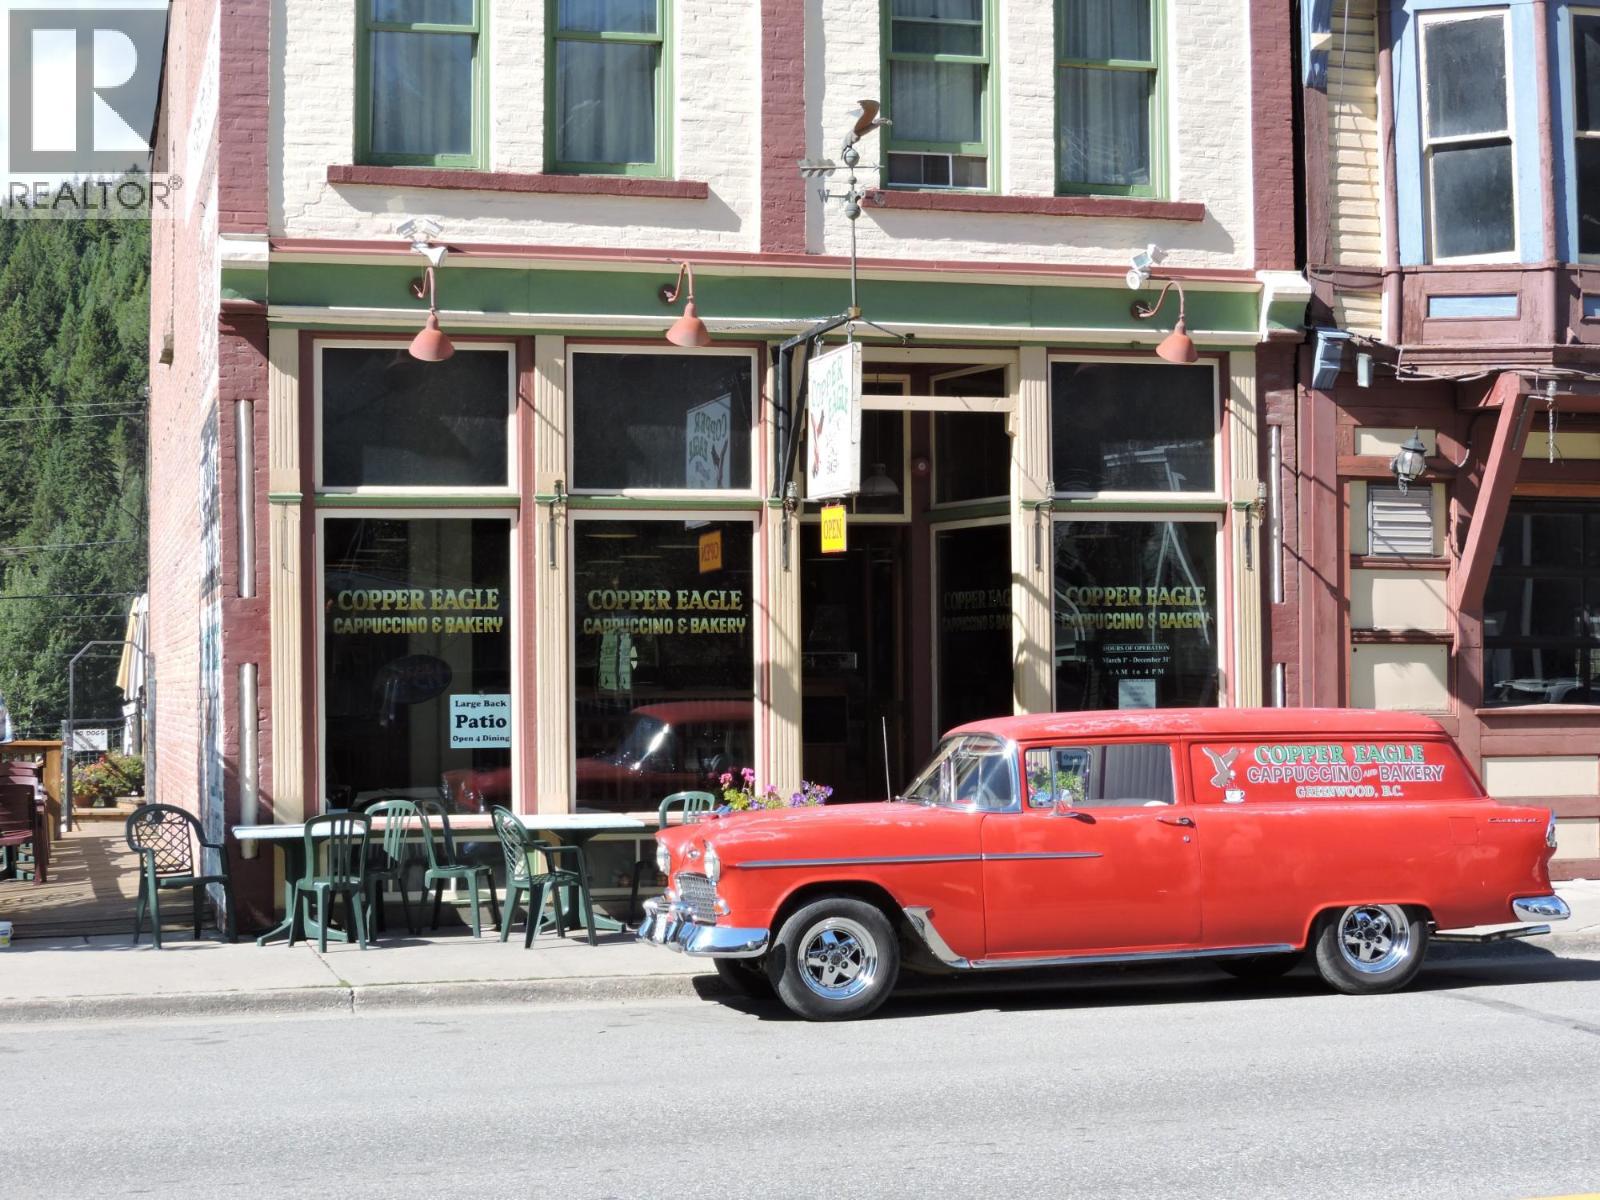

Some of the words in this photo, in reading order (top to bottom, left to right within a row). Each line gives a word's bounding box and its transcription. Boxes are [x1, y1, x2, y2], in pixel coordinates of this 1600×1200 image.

[823, 517, 842, 540] OPEN
[337, 589, 426, 610] COPPER
[429, 588, 500, 610] EAGLE
[586, 589, 673, 610] COPPER
[675, 589, 743, 610] EAGLE
[1066, 586, 1143, 606] COPPER
[1145, 586, 1207, 606] EAGLE
[333, 616, 428, 634] CAPPUCCINO
[431, 616, 442, 634] &
[444, 616, 503, 634] BAKERY
[583, 617, 674, 635] CAPPUCCINO
[677, 617, 688, 634] &
[690, 617, 746, 634] BAKERY
[455, 700, 481, 708] Large
[455, 714, 507, 728] Patio
[1254, 744, 1346, 766] COPPER
[1353, 743, 1426, 765] EAGLE
[1247, 765, 1363, 783] CAPPUCCINO
[1379, 764, 1445, 782] BAKERY
[1295, 785, 1379, 799] GREENWOOD,
[1381, 784, 1404, 798] B.C.
